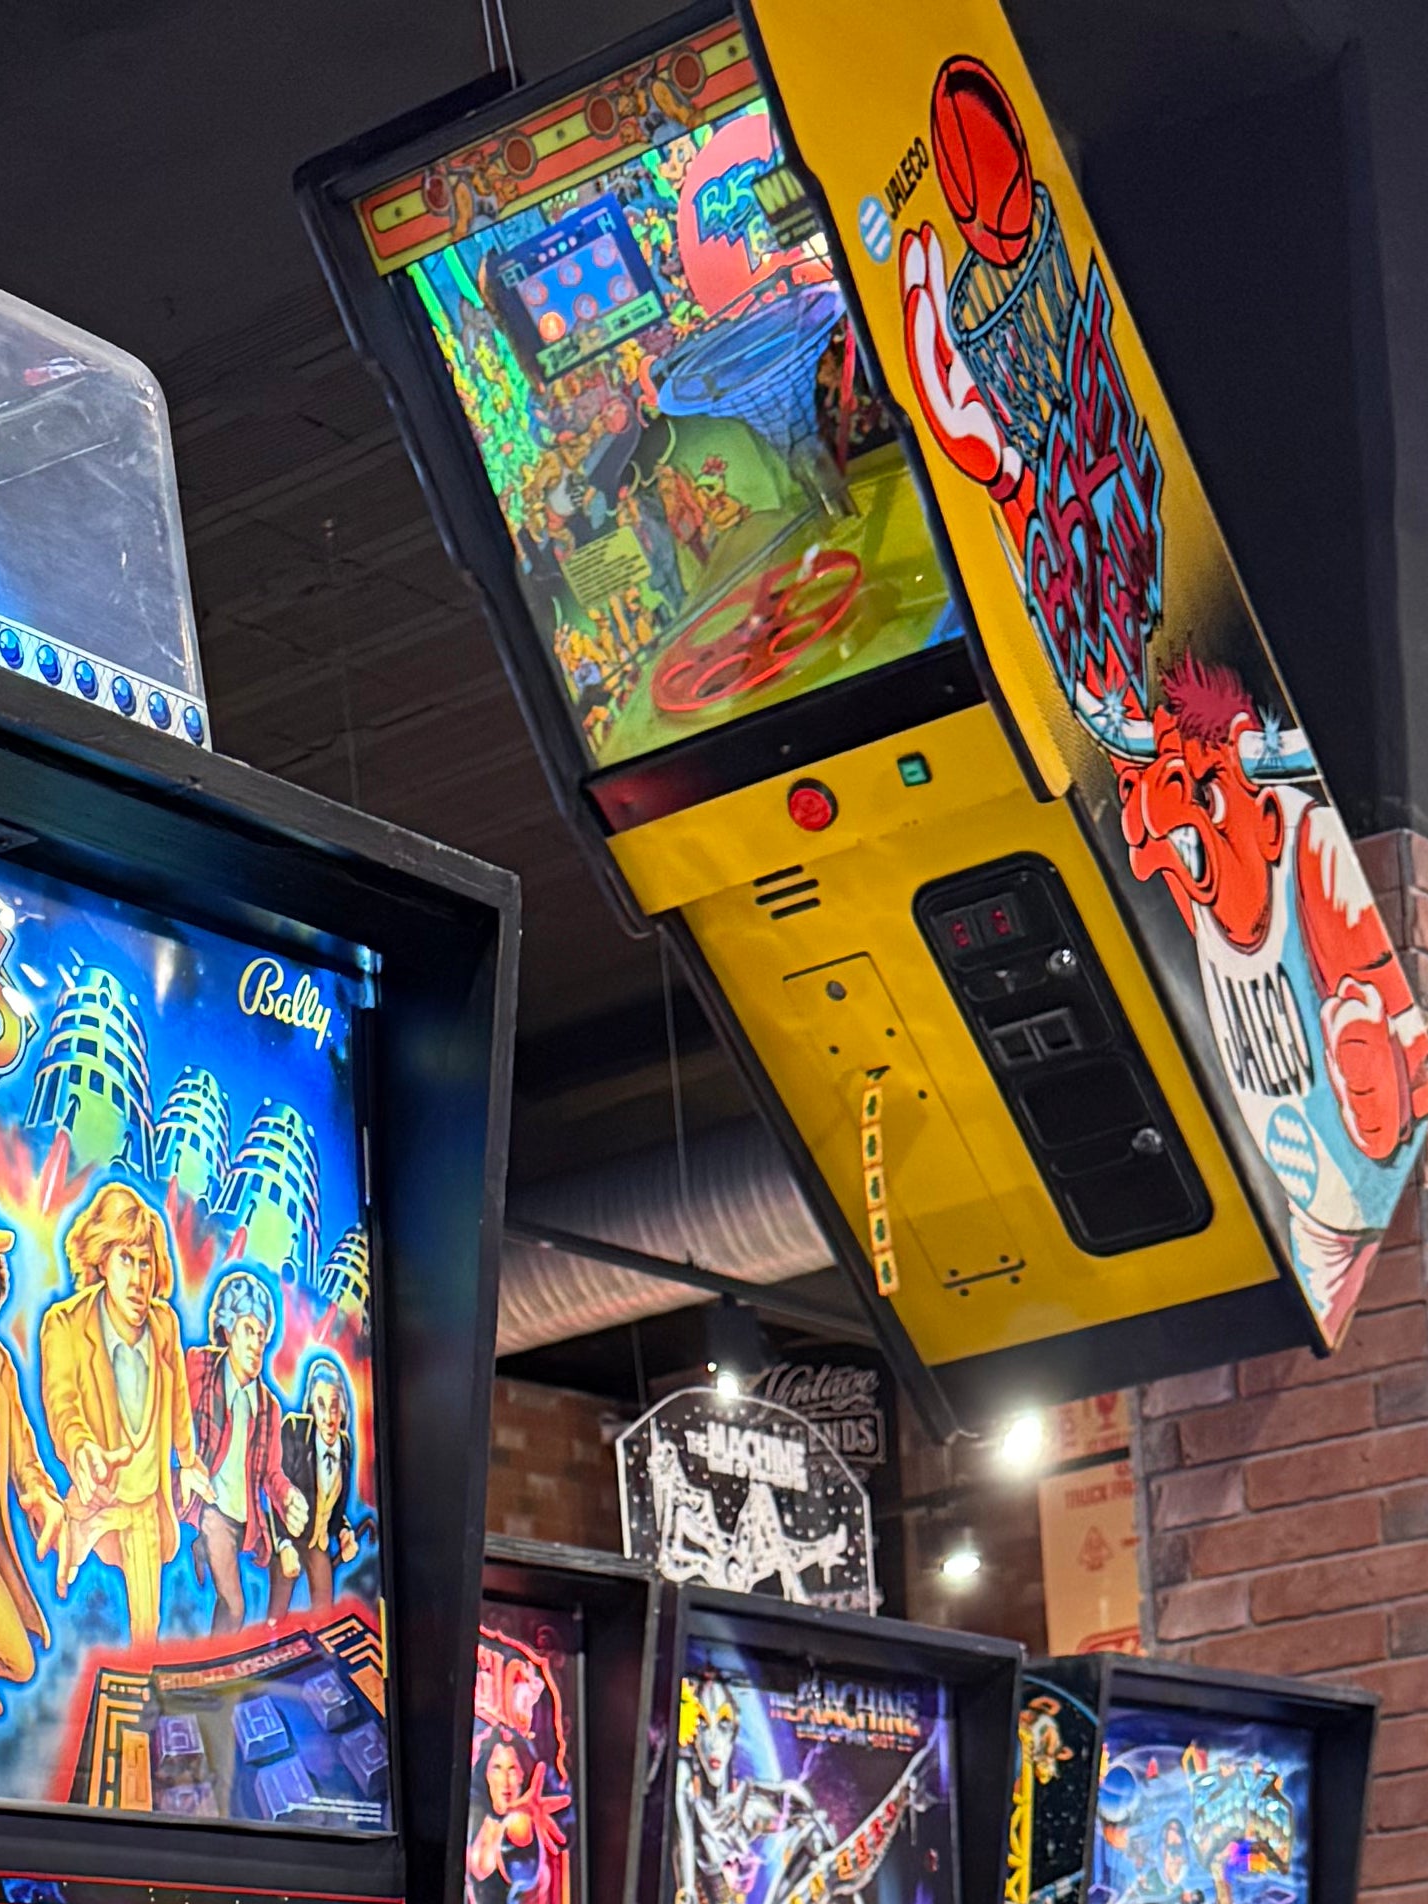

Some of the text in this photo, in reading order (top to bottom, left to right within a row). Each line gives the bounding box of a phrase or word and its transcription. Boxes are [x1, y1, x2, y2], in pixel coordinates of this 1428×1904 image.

[884, 137, 929, 220] JALECO
[238, 957, 332, 1050] Bally
[1208, 961, 1315, 1097] JALECO
[707, 1421, 808, 1491] MACHINE
[796, 1679, 922, 1738] MACHINE
